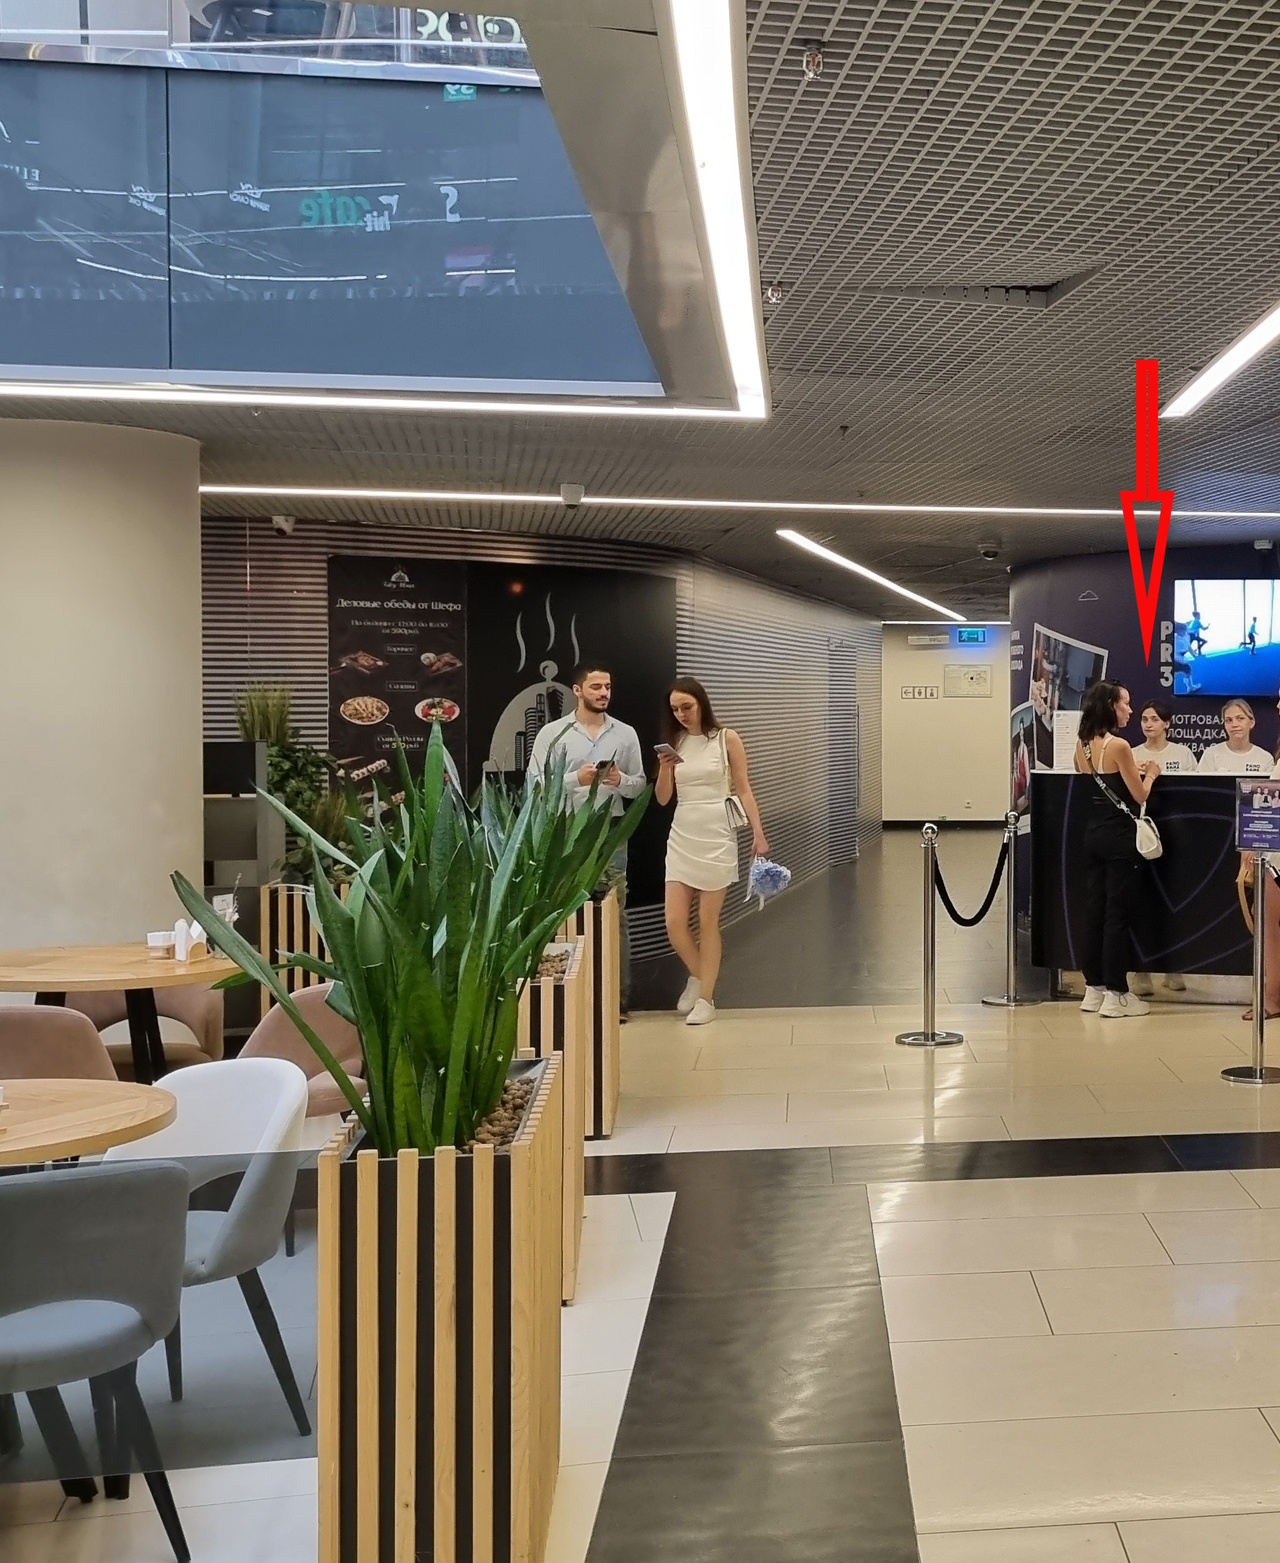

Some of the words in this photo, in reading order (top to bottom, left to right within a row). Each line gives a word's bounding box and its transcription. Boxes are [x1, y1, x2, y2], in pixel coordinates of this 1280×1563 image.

[336, 598, 382, 609] Деловые
[384, 599, 416, 609] обеды
[418, 601, 429, 610] от
[431, 601, 462, 612] Шефа
[1171, 714, 1224, 725] ОТРОВА
[1167, 728, 1227, 740] ЛОЩАДКА
